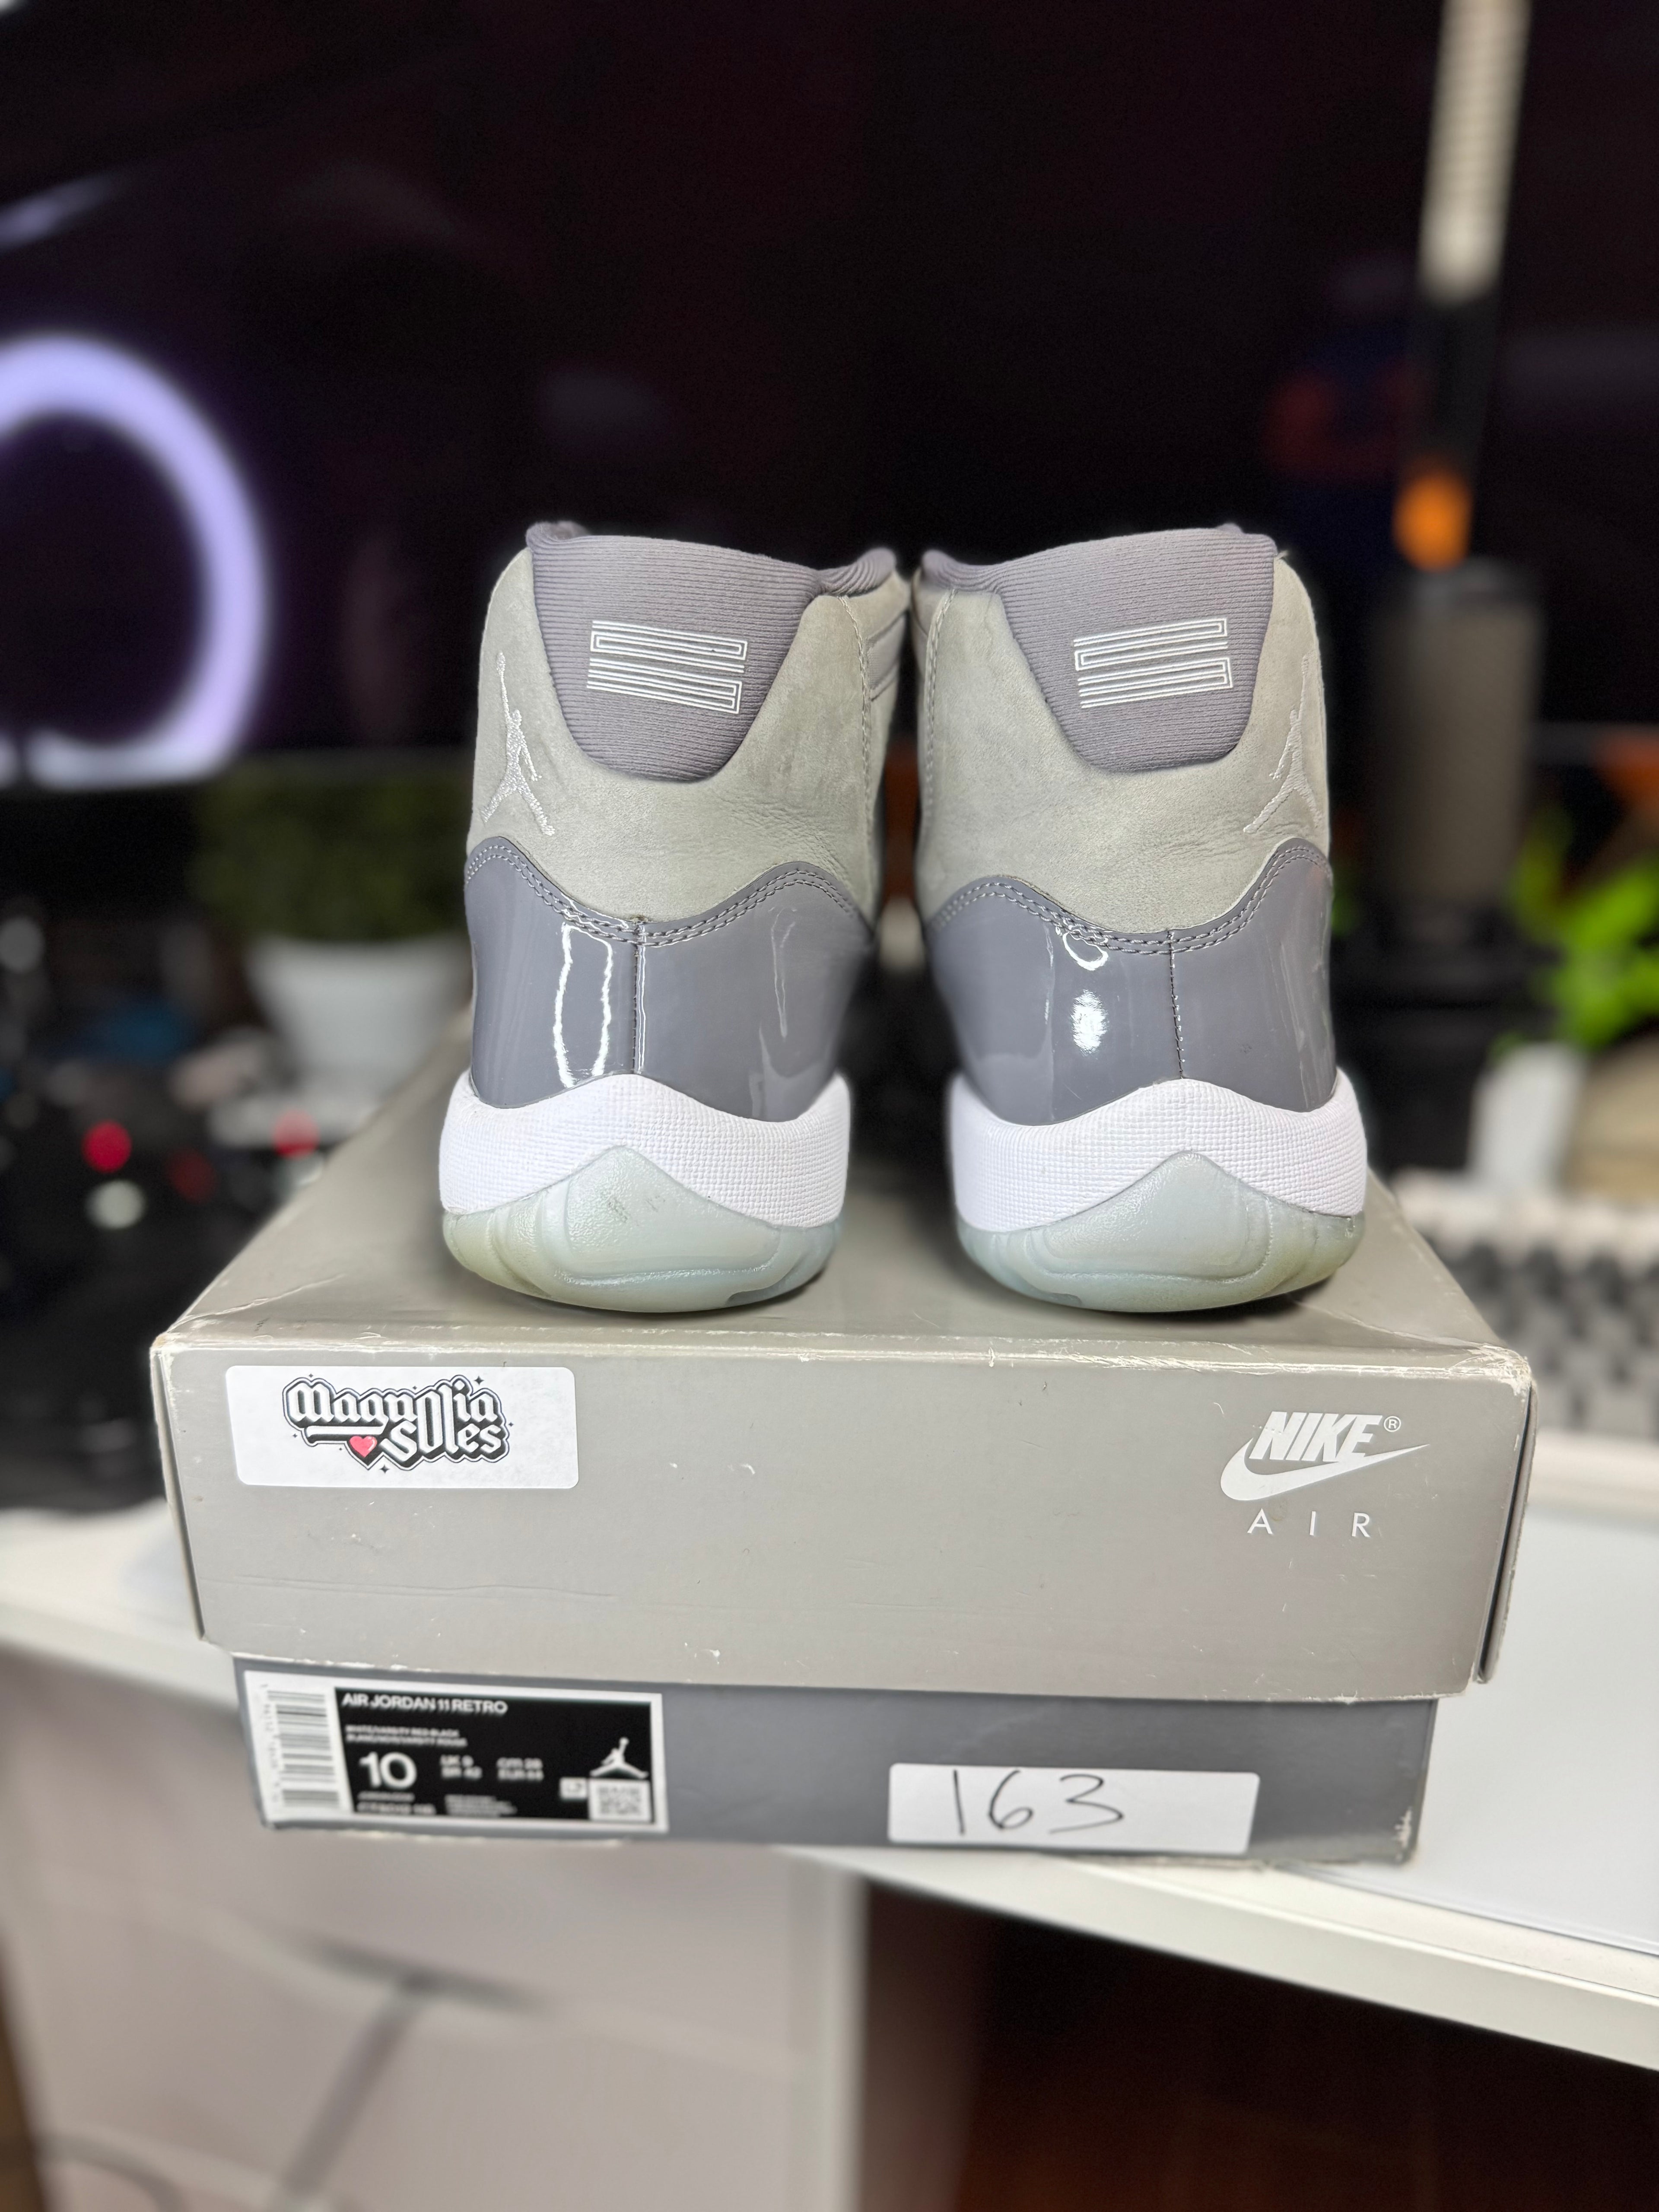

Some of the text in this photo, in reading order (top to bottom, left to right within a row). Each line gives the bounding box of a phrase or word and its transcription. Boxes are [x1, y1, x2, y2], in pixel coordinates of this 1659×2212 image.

[1247, 1508, 1370, 1538] AIR
[342, 1692, 509, 1715] AIR JORDAN 11 RETRO
[359, 1751, 417, 1789] 10
[953, 1770, 1124, 1834] 163
